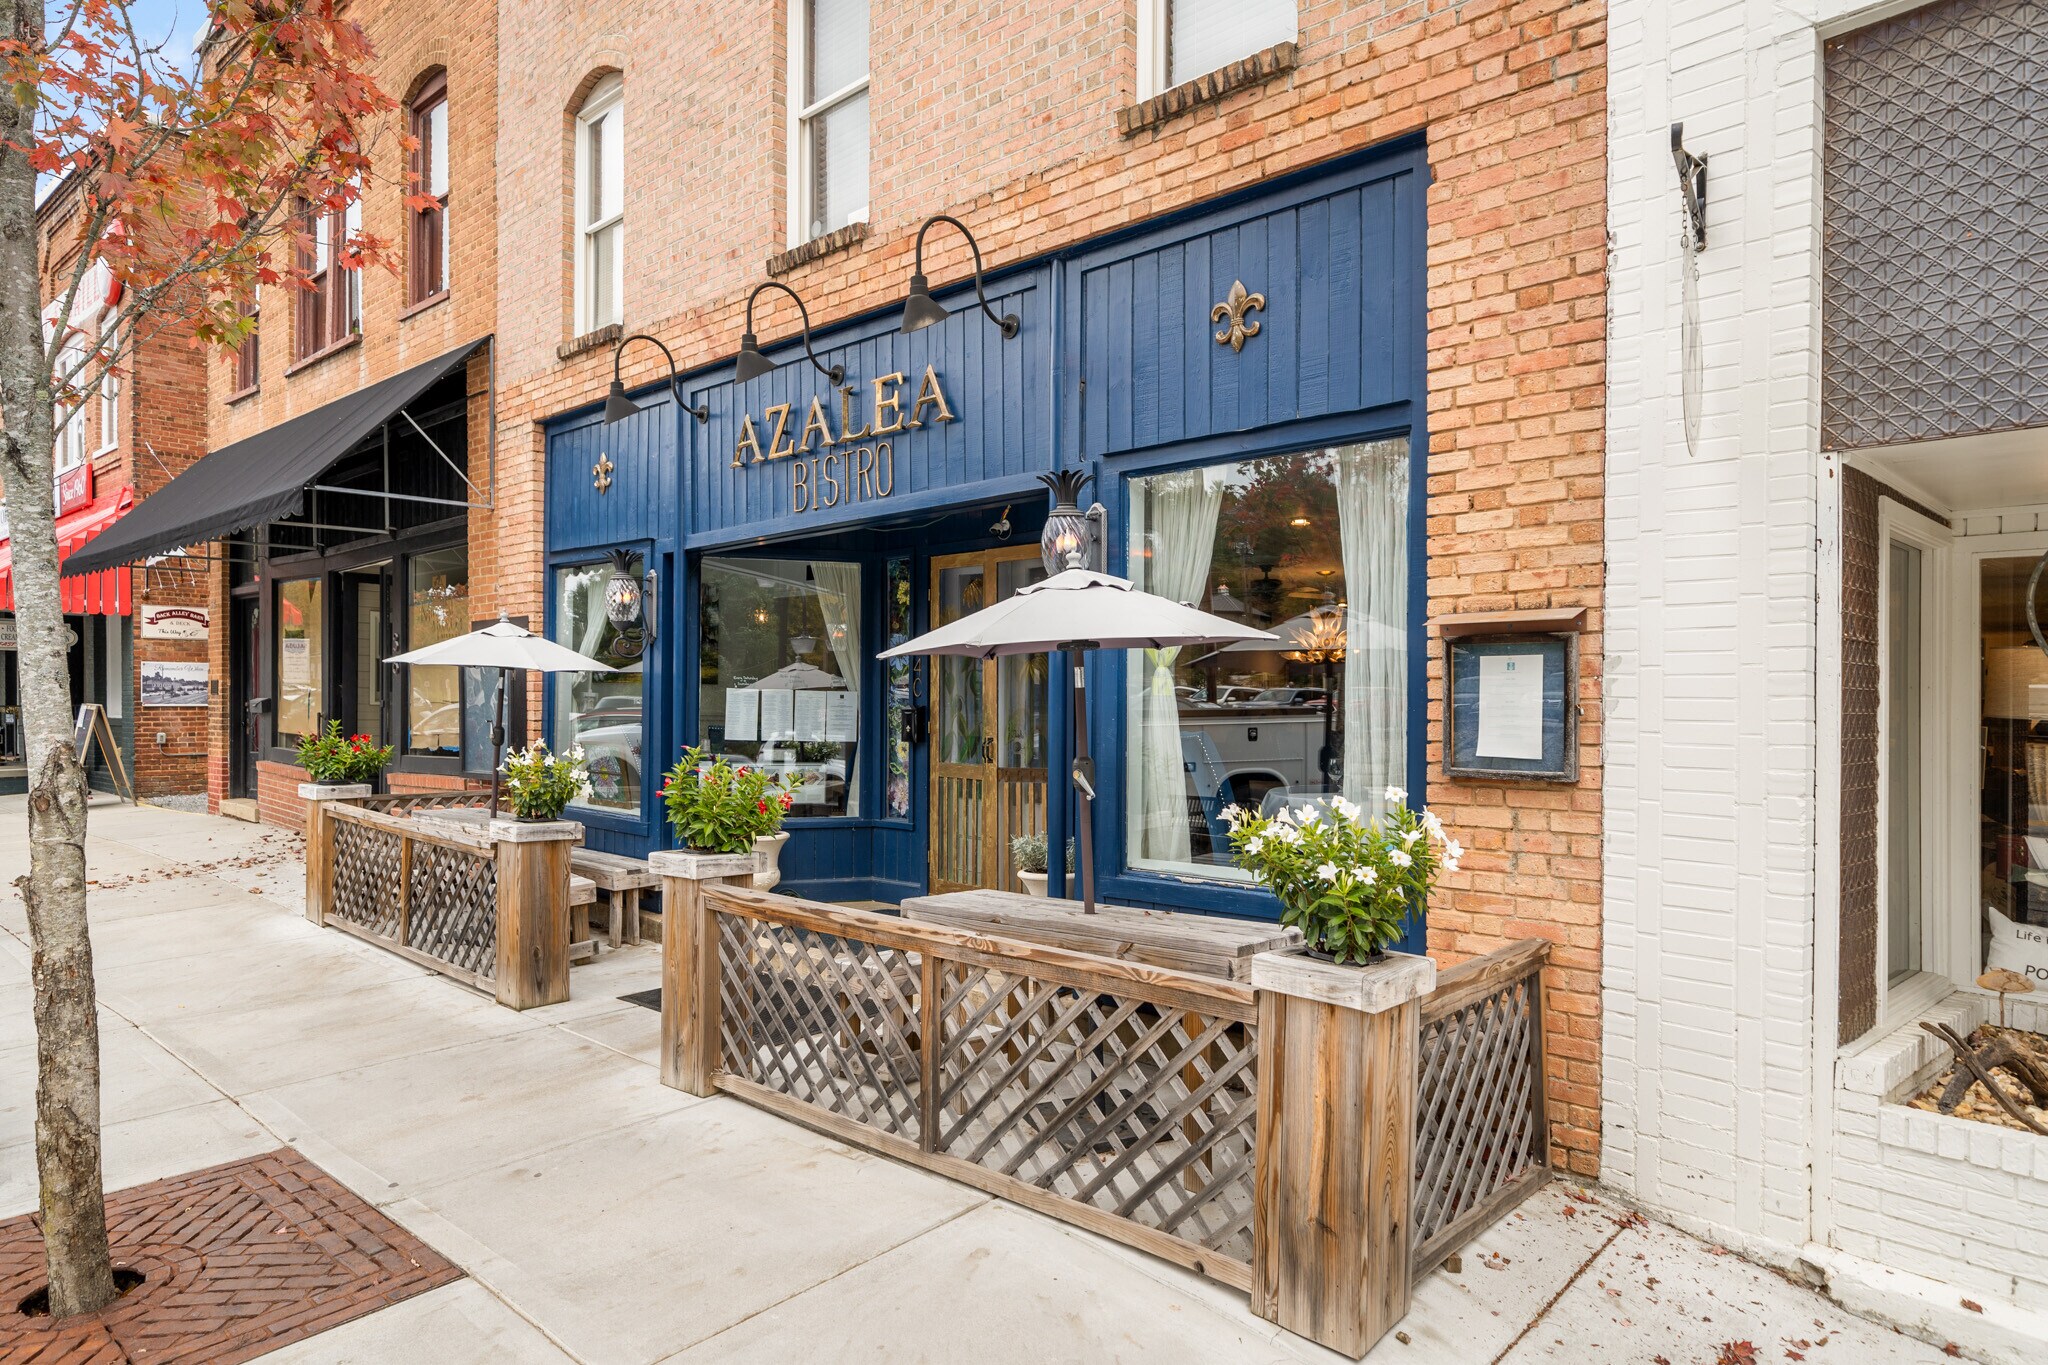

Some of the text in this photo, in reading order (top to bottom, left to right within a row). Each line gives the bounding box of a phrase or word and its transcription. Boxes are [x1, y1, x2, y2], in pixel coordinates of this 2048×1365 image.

[730, 363, 954, 468] AZALEA
[794, 442, 893, 513] BISTRO
[156, 611, 171, 619] BACK
[1, 633, 17, 641] CREA
[2016, 929, 2042, 943] Life
